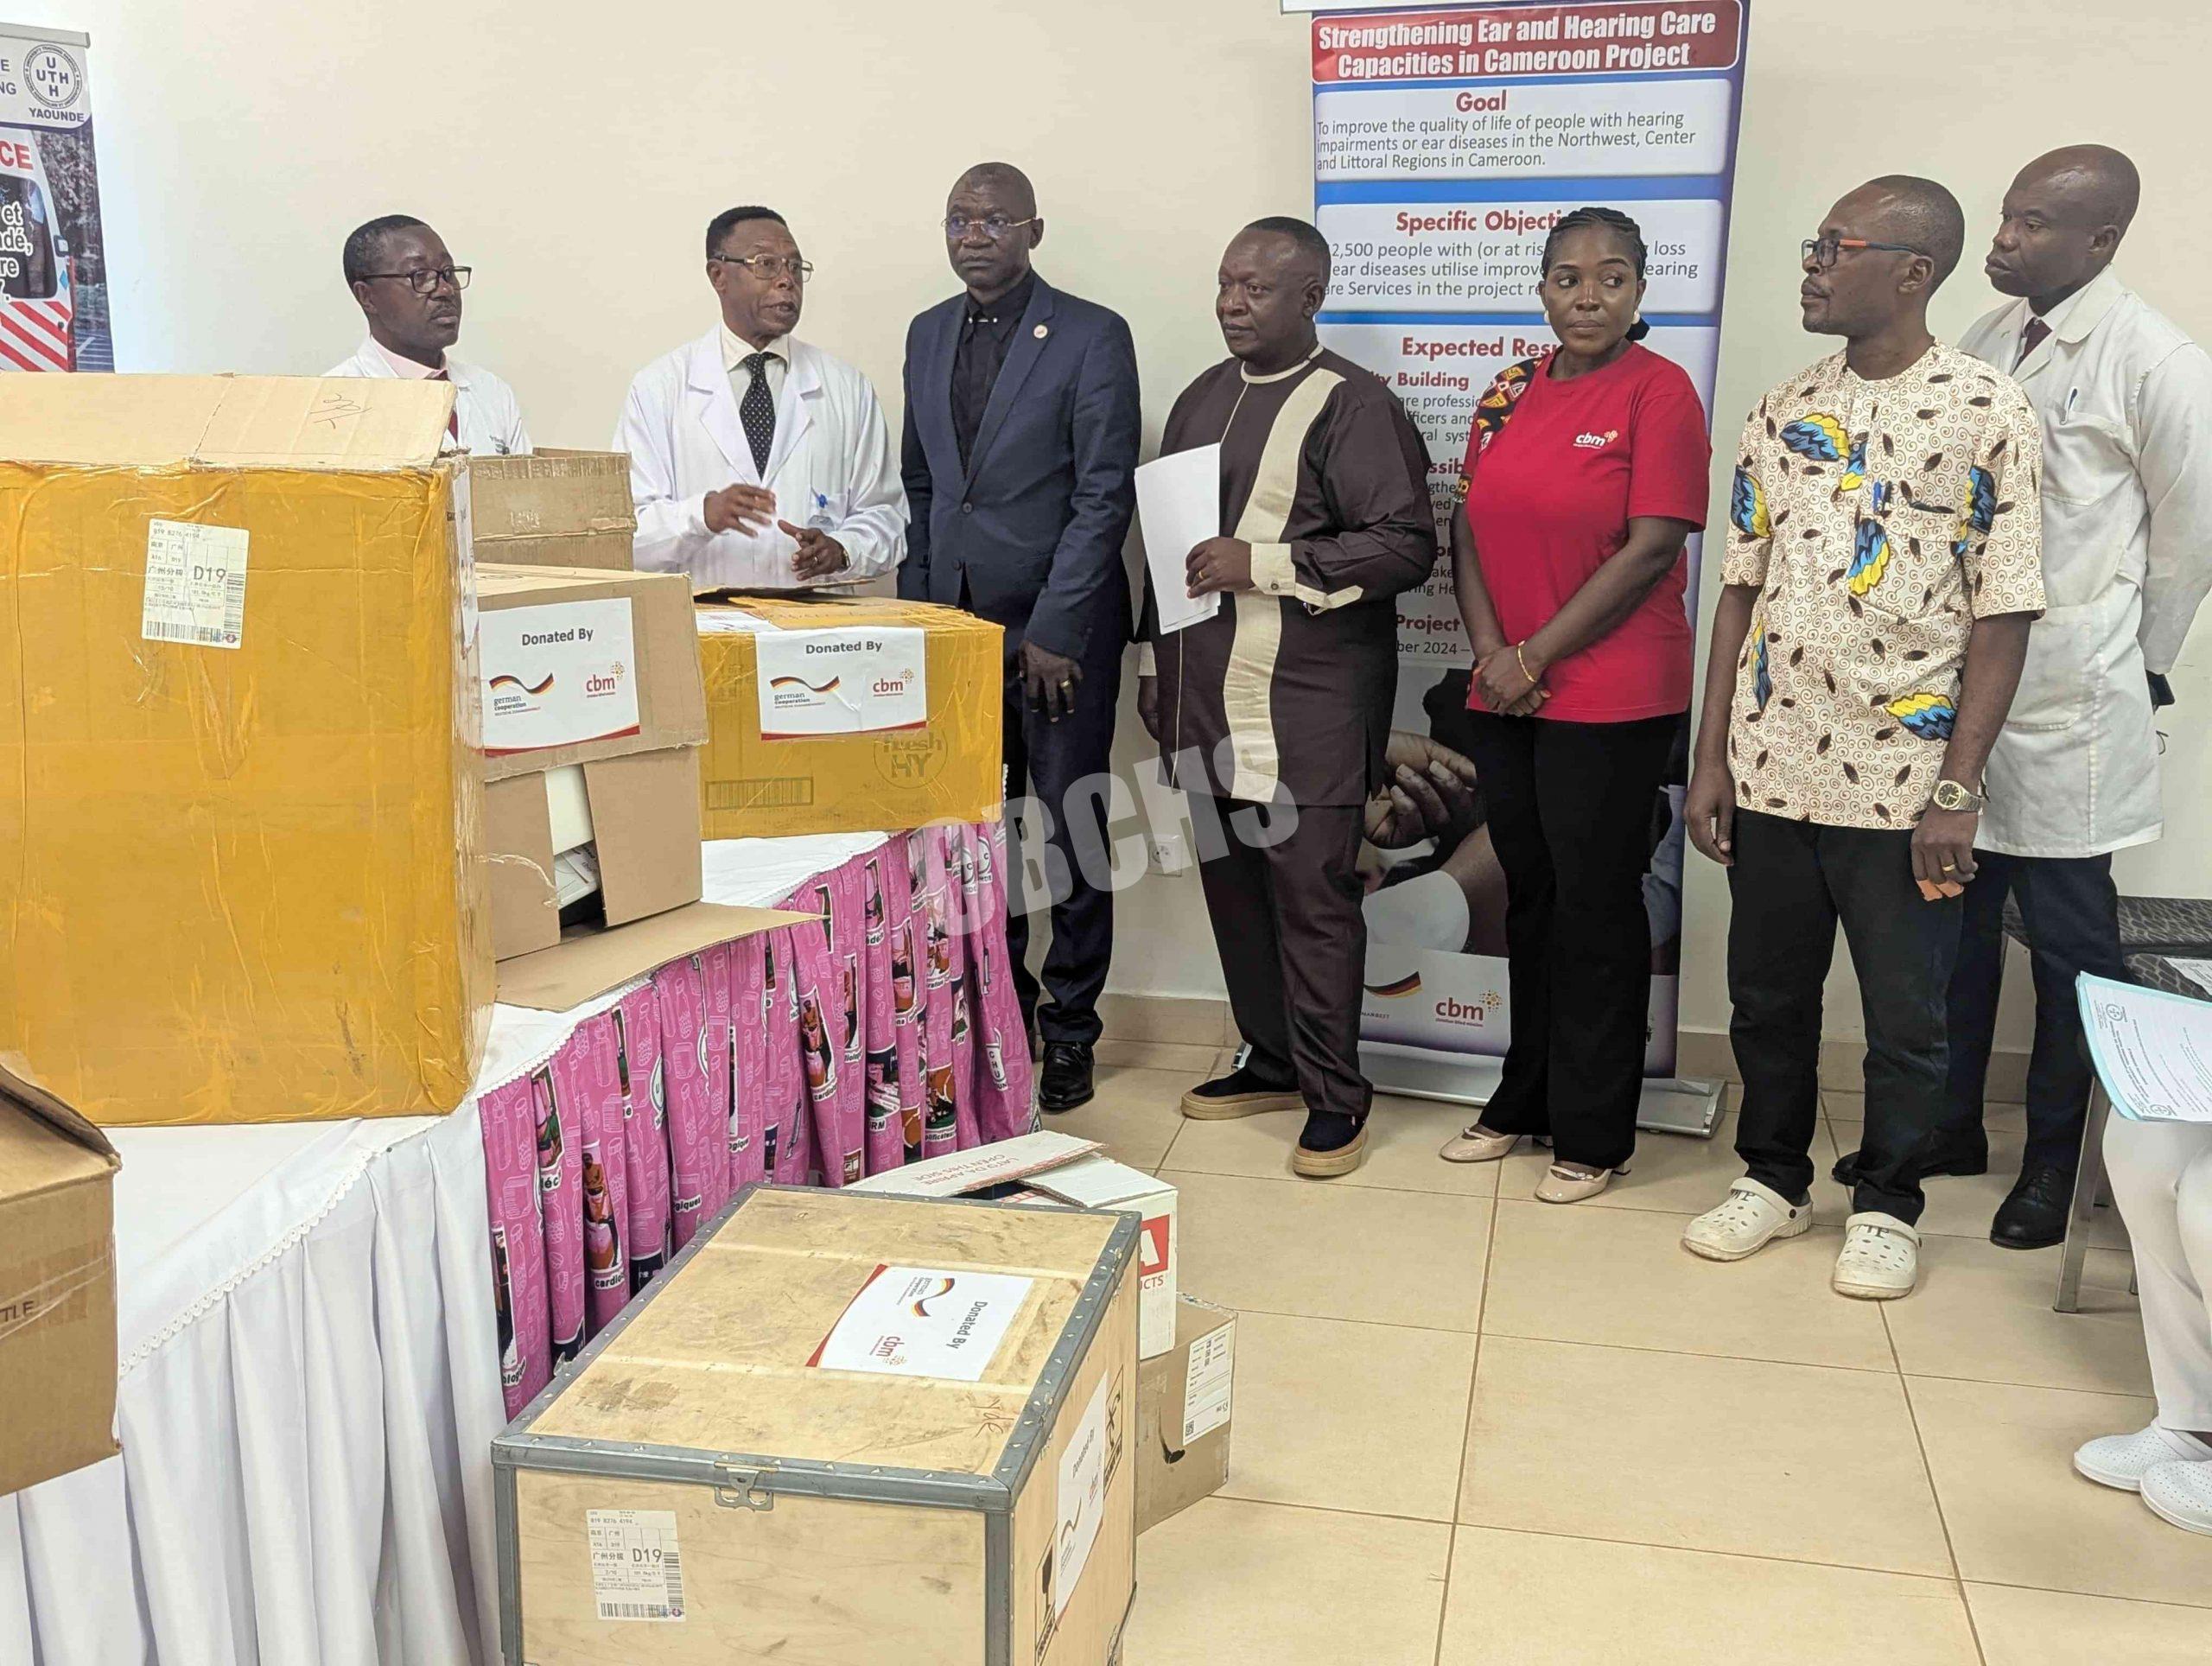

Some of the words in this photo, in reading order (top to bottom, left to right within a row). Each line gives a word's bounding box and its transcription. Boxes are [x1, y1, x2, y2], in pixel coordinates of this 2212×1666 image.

[1319, 22, 1472, 50] Strengthening
[1478, 19, 1512, 42] Ear
[1516, 16, 1559, 41] and
[1564, 13, 1655, 40] Hearing
[1660, 10, 1716, 36] Care
[1339, 53, 1453, 79] Capacities
[1459, 50, 1479, 74] in
[1484, 48, 1599, 73] Cameroon
[1605, 43, 1690, 69] Project
[36, 68, 69, 84] UTH
[1456, 90, 1507, 112] Goal
[29, 107, 84, 122] YAOUNDE
[1318, 122, 1329, 135] To
[1332, 120, 1388, 137] improve
[1392, 118, 1415, 132] the
[1419, 117, 1468, 134] quality
[1472, 116, 1487, 130] of
[1491, 115, 1512, 130] life
[1516, 114, 1532, 130] of
[1535, 113, 1586, 132] people
[1590, 111, 1622, 127] with
[1627, 111, 1684, 129] hearing
[1317, 137, 1398, 154] impairments
[1402, 139, 1417, 149] or
[1421, 138, 1445, 149] ear
[1449, 135, 1508, 149] diseases
[1512, 133, 1524, 148] in
[1529, 133, 1554, 147] the
[1558, 131, 1640, 148] Northwest,
[1645, 130, 1696, 145] Center
[1317, 156, 1337, 170] and
[1340, 154, 1388, 169] Littoral
[1393, 154, 1447, 171] Regions
[1452, 153, 1464, 167] in
[1469, 153, 1546, 168] Cameroon.
[3, 203, 22, 225] et
[1396, 210, 1477, 236] Specific
[0, 227, 31, 254] dé,
[1654, 240, 1686, 256] loss
[1328, 243, 1373, 258] 2,500
[1377, 242, 1432, 259] people
[1438, 242, 1471, 257] with
[1478, 241, 1499, 259] (or
[1504, 243, 1519, 257] at
[1332, 264, 1356, 276] ear
[1360, 262, 1426, 276] diseases
[1431, 261, 1478, 276] utilise
[1349, 281, 1412, 296] Services
[1417, 281, 1431, 296] in
[1436, 281, 1463, 296] the
[1468, 280, 1522, 299] project
[1402, 336, 1503, 360] Expected
[1397, 372, 1469, 391] Building
[1575, 432, 1605, 447] cbm
[194, 565, 226, 583] D19
[1396, 614, 1460, 634] Project
[522, 629, 575, 646] Donated
[578, 628, 594, 641] By
[805, 641, 861, 654] Donated
[867, 640, 883, 652] By
[1423, 642, 1458, 654] 2024
[586, 674, 615, 692] cbm
[873, 677, 904, 692] cbm
[494, 696, 521, 706] german
[1435, 996, 1484, 1021] cbm
[956, 1301, 988, 1336] Donated
[876, 1336, 905, 1358] cbm
[946, 1338, 967, 1349] By
[632, 1548, 662, 1563] D19
